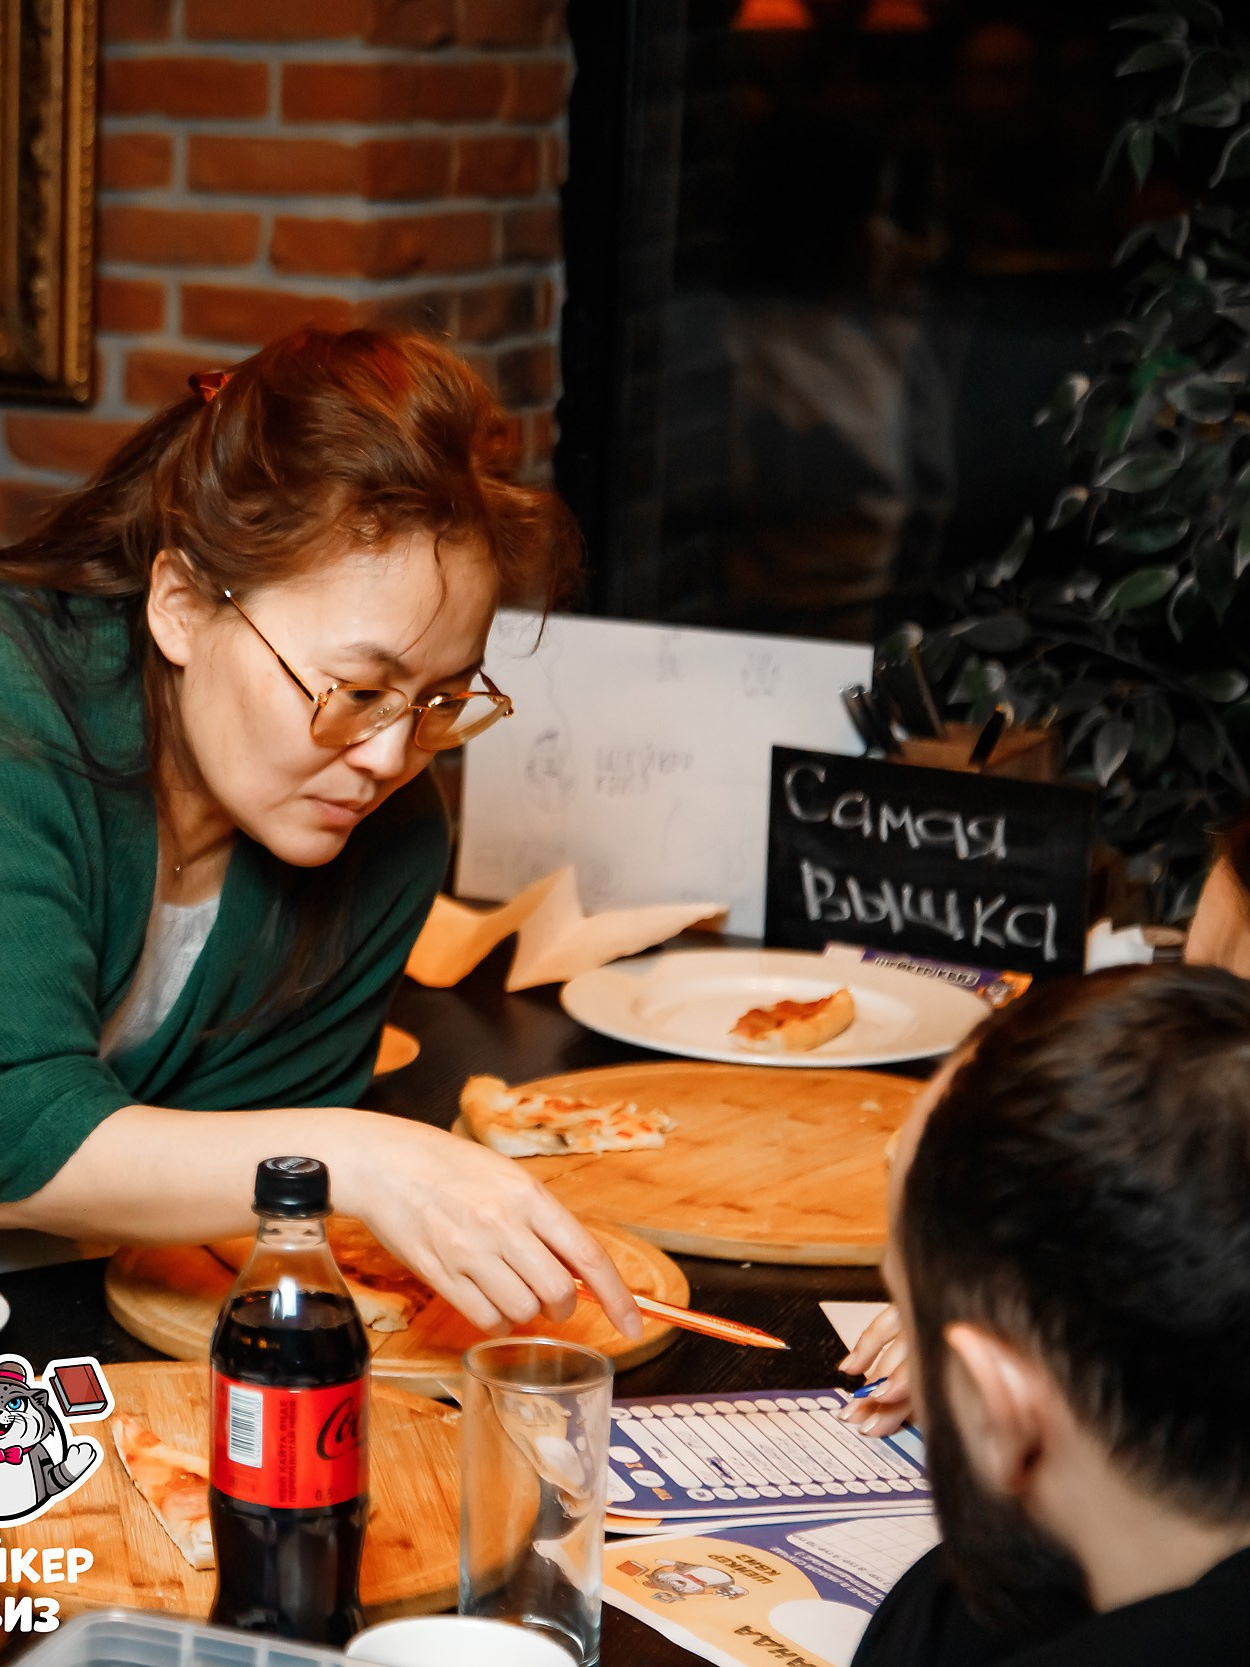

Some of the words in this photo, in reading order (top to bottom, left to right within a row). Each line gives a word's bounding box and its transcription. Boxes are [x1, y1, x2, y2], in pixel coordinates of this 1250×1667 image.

[784, 762, 1007, 860] Самая
[800, 858, 1057, 961] Вышка
[708, 1554, 773, 1584] ШЕЙКЕР
[735, 1554, 781, 1576] КВИЗ
